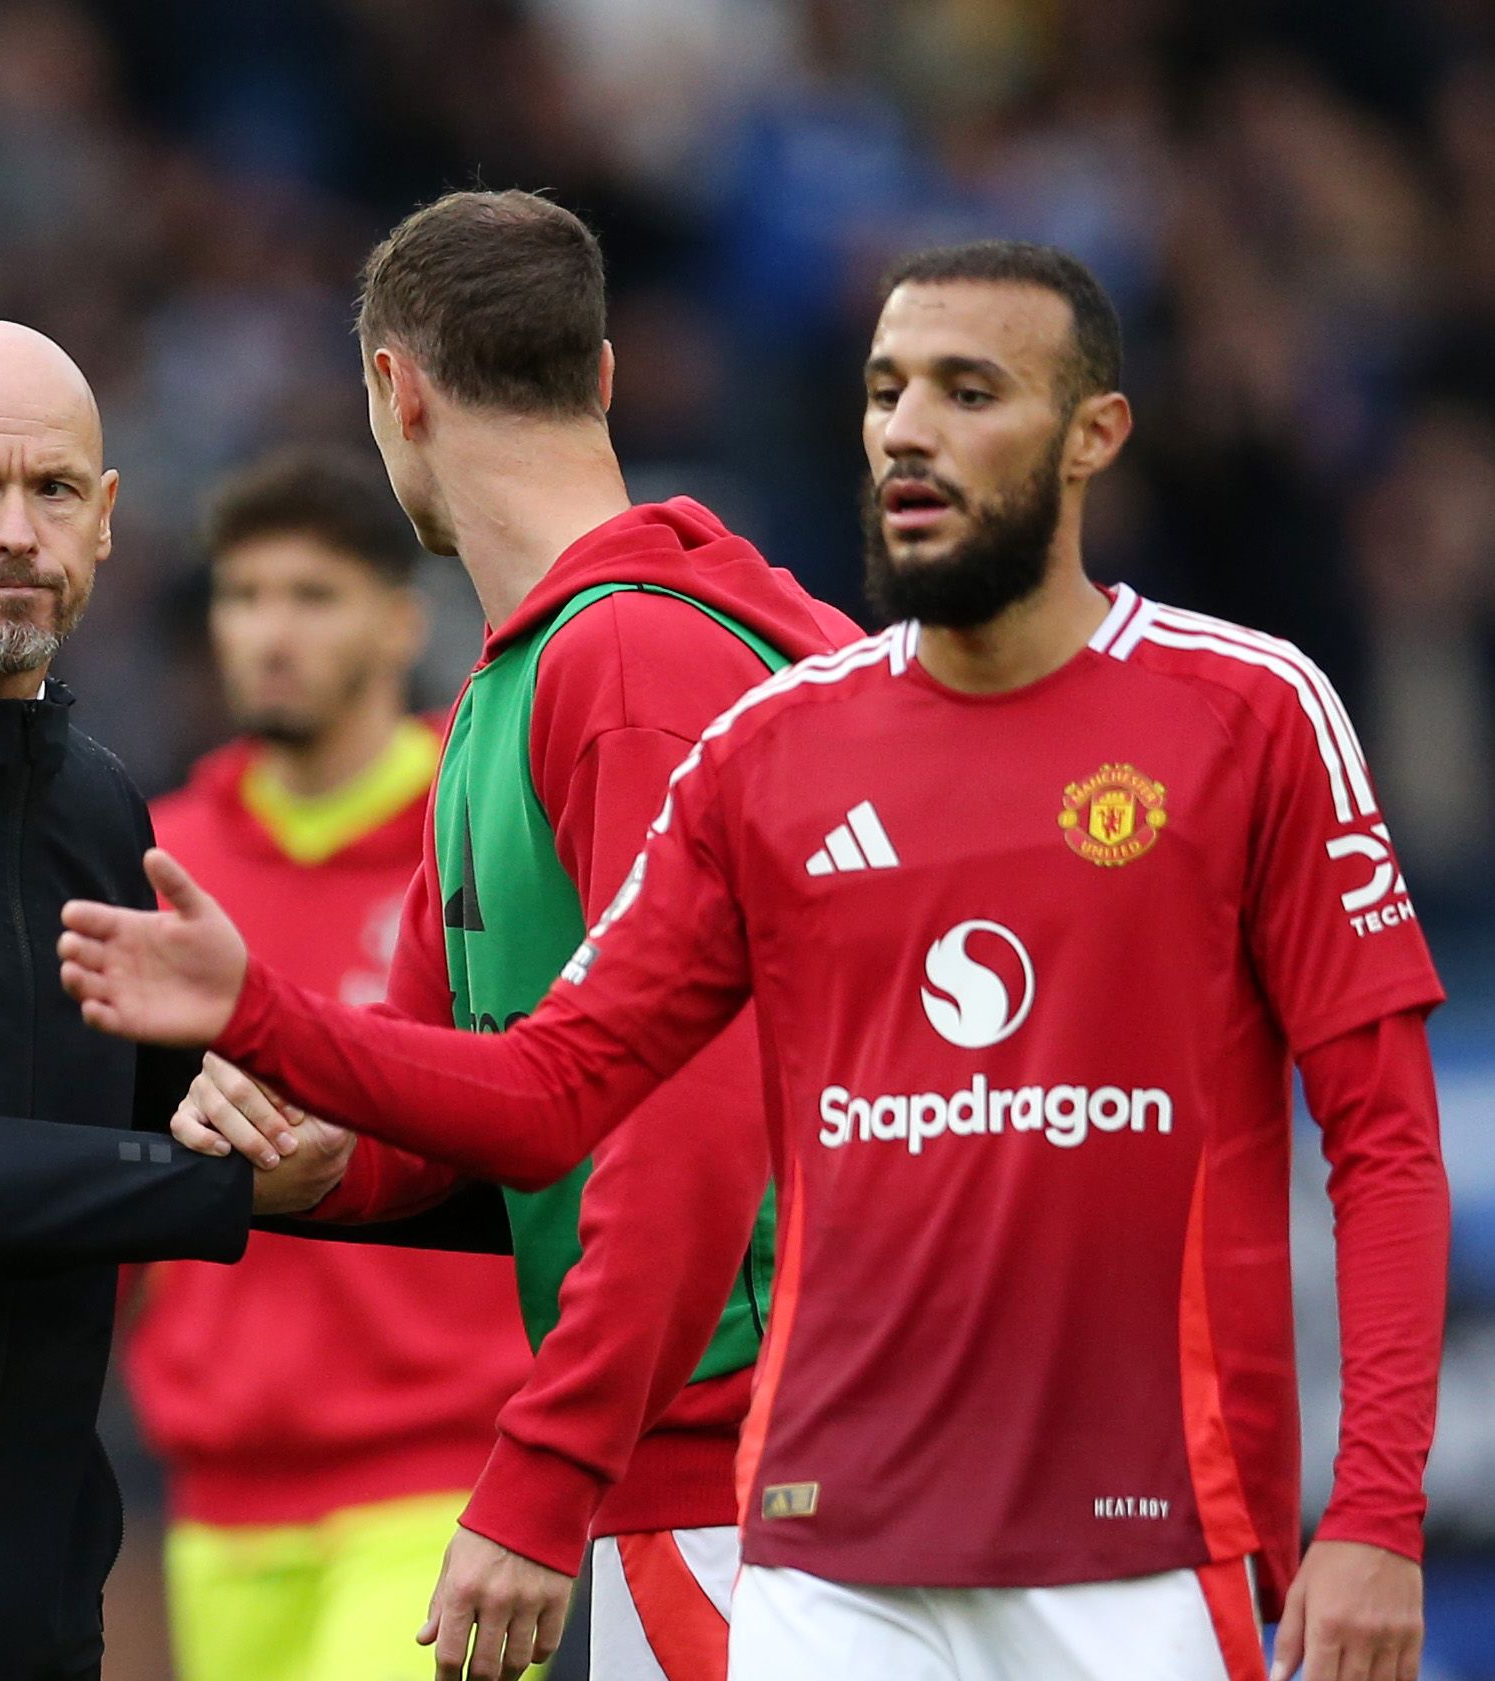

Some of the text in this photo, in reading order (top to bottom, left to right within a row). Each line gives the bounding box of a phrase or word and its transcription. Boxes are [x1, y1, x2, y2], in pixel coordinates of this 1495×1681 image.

[1081, 840, 1141, 859] UNITED
[1349, 898, 1416, 938] TECH
[819, 1073, 1172, 1155] Snapdragon
